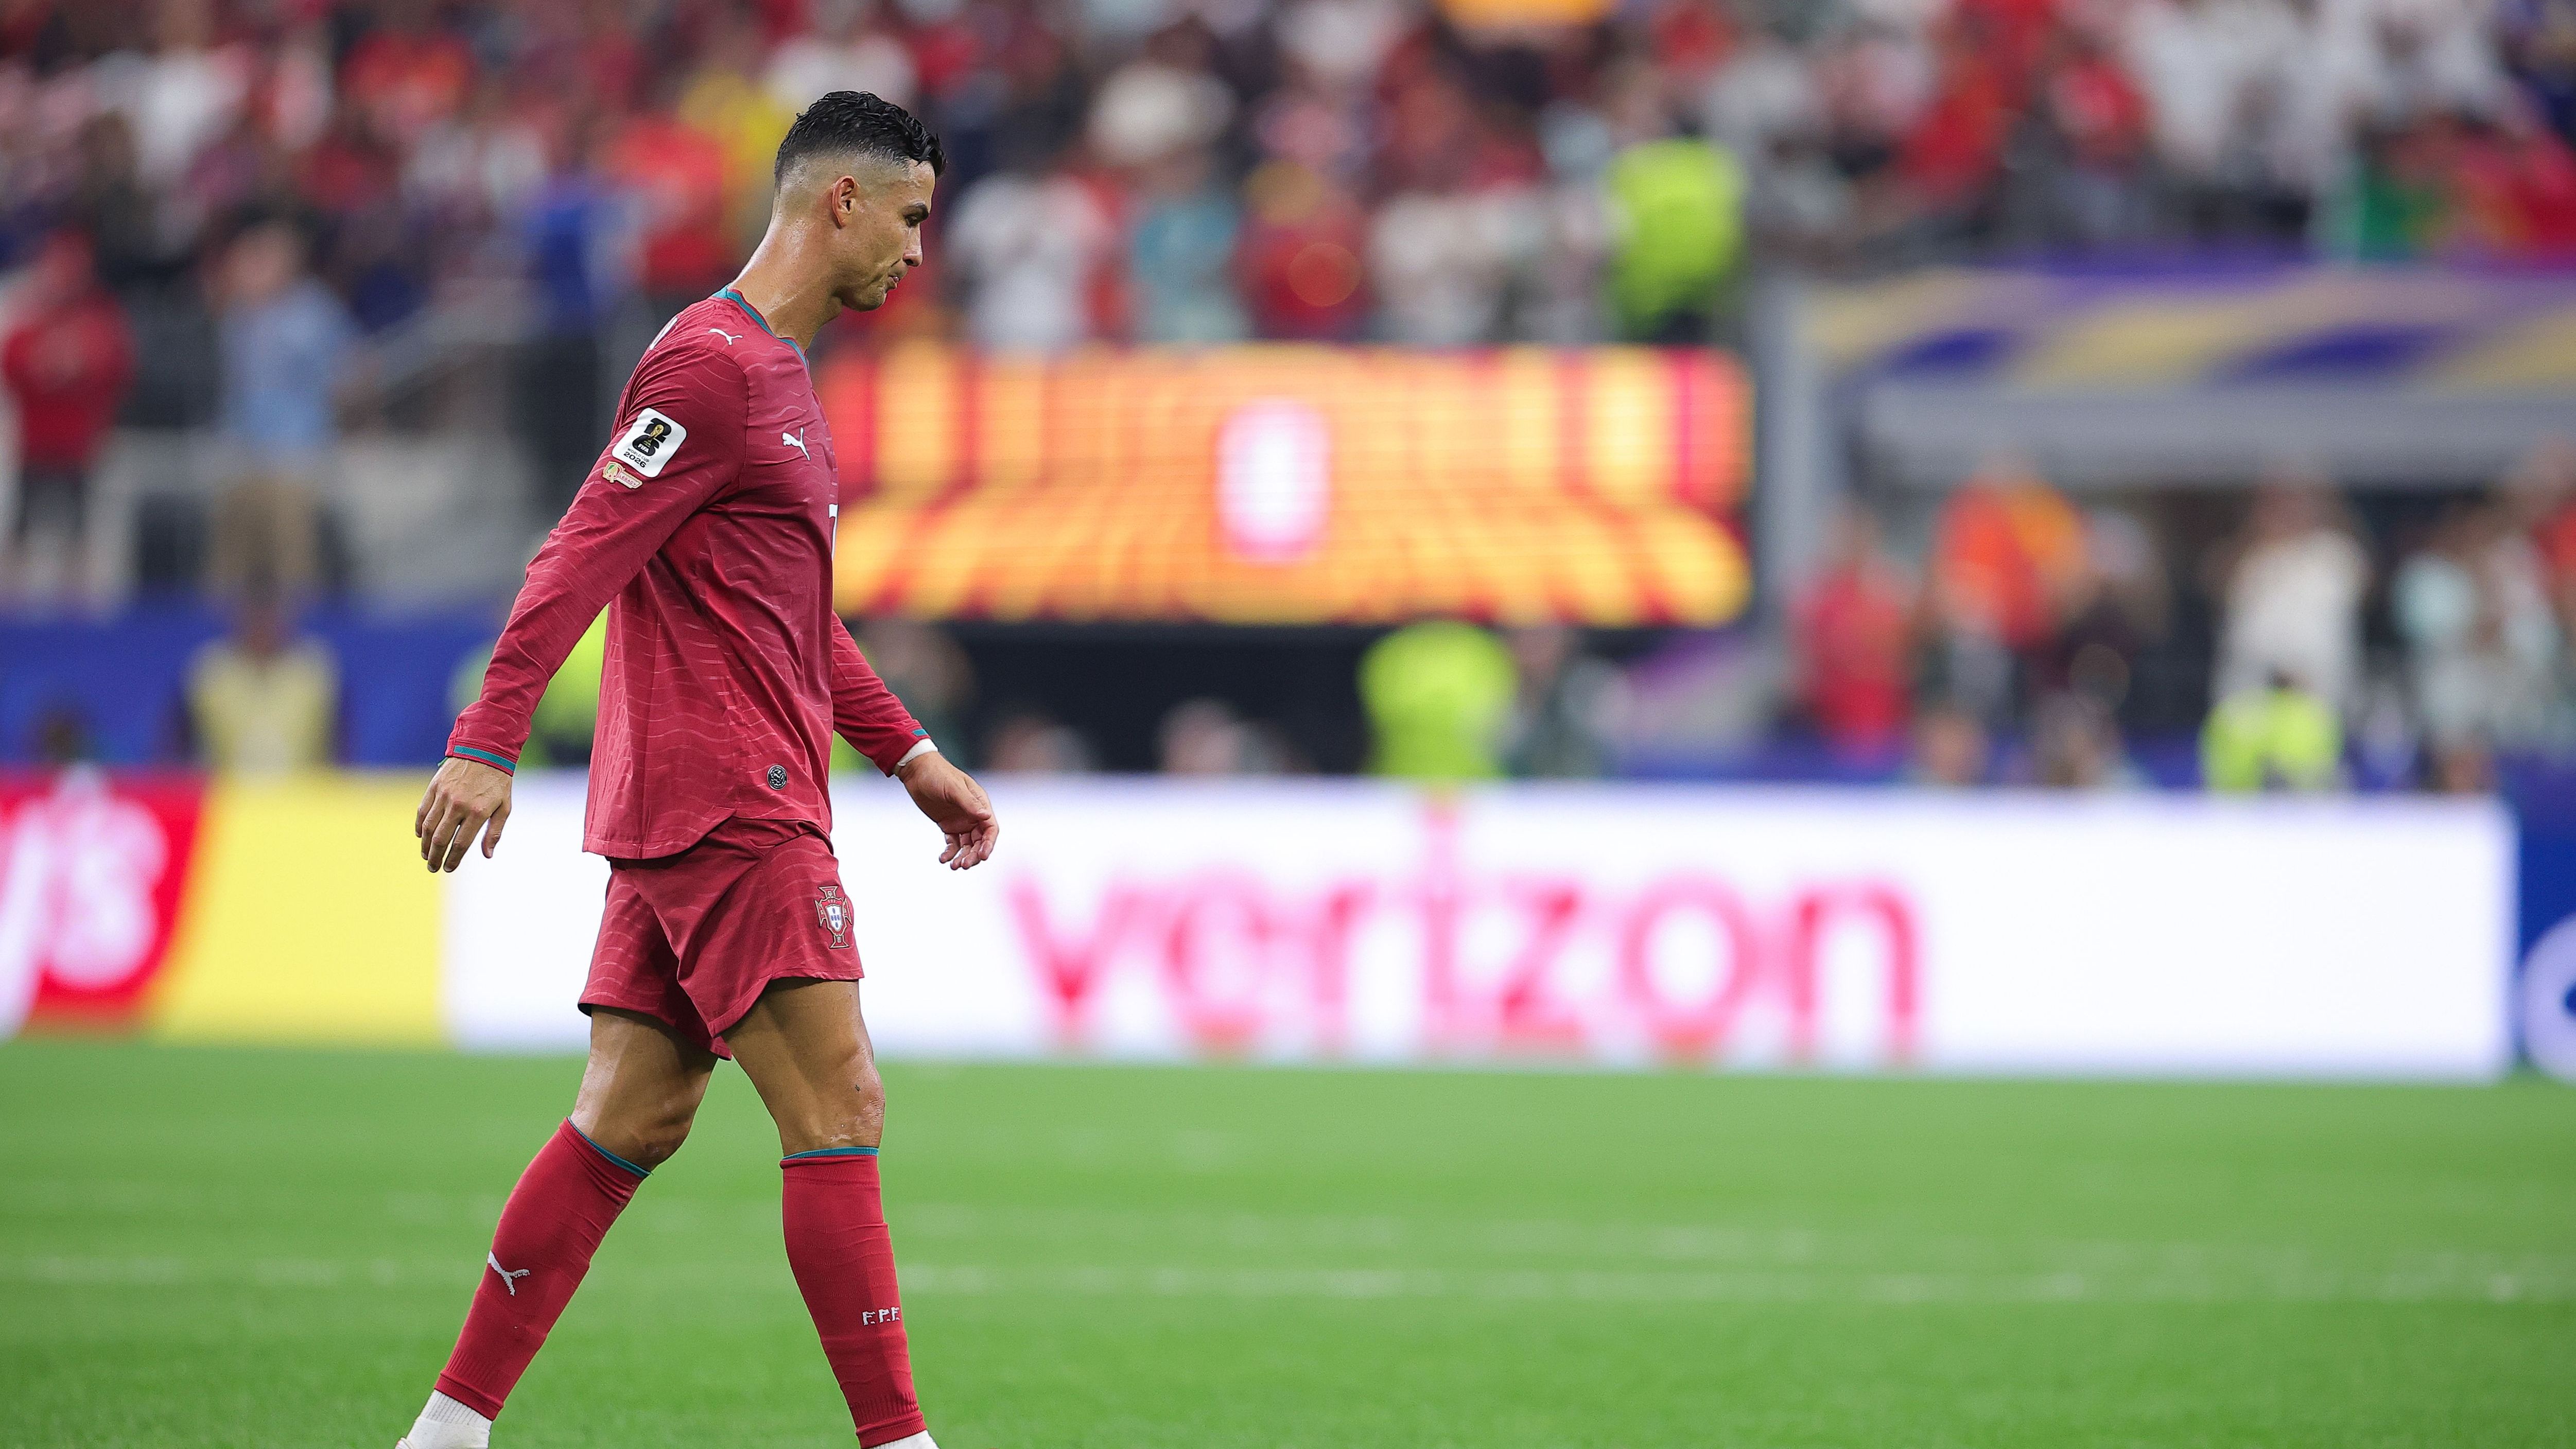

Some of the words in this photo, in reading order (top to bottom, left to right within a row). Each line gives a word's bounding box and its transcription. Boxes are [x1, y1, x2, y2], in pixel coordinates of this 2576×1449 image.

[628, 448, 641, 457] WORLD
[638, 443, 649, 453] FIFA
[623, 451, 647, 468] 2026
[619, 474, 637, 486] LEGACY
[1009, 795, 1921, 1059] verizon
